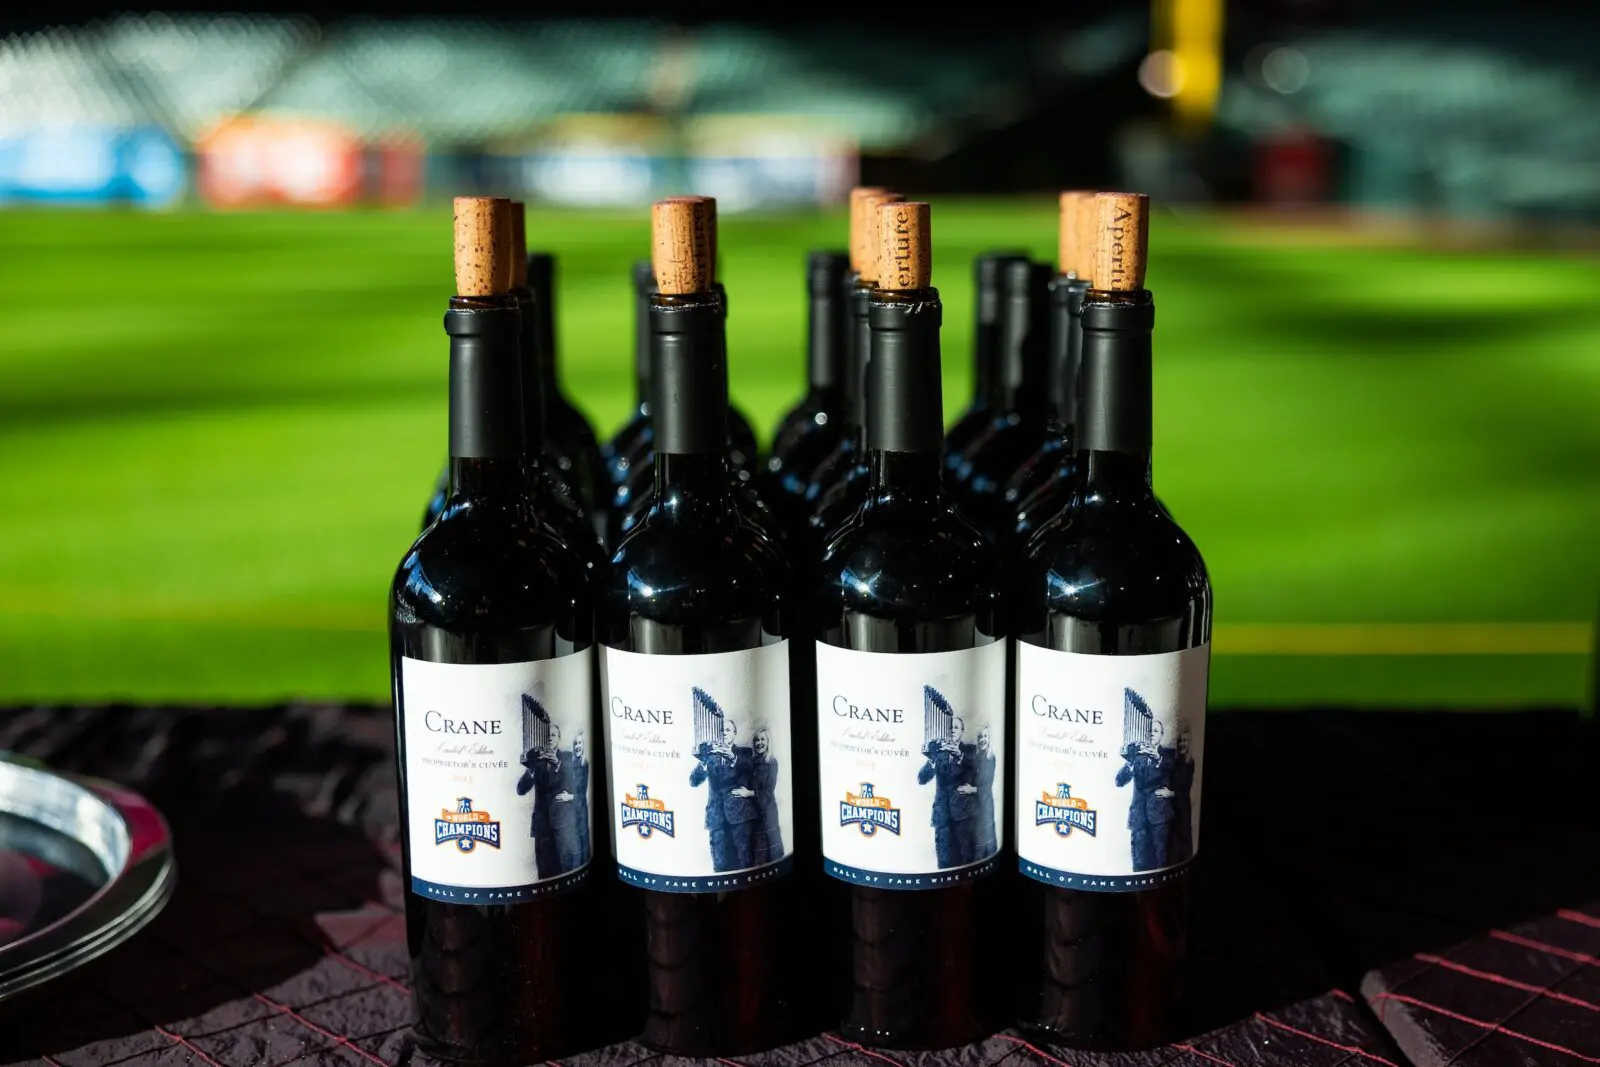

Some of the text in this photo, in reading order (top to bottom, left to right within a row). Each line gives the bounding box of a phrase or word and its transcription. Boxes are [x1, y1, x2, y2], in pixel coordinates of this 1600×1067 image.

[895, 212, 911, 287] erture
[611, 696, 674, 725] CRANE
[832, 695, 904, 723] CRANE
[1031, 694, 1104, 725] CRANE
[425, 710, 502, 735] CRANE
[422, 756, 509, 769] PROPRIETOR'S CUVÉE
[653, 750, 681, 760] CUVÉE
[881, 747, 910, 758] CUVÉE
[1078, 750, 1109, 760] CUVÉE
[855, 798, 881, 807] WORLD
[453, 814, 479, 823] WORLD
[622, 806, 672, 831] CHAMPIONS
[841, 804, 898, 828] CHAMPIONS
[1037, 804, 1094, 830] CHAMPIONS
[436, 822, 498, 842] CHAMPIONS
[665, 880, 697, 888] FAME
[707, 878, 738, 887] WINE
[747, 867, 780, 882] EVENT
[865, 875, 879, 883] OF
[888, 877, 921, 885] FAME
[930, 874, 960, 884] WINE
[1082, 879, 1116, 887] FAME
[1125, 878, 1155, 887] WINE
[489, 891, 522, 899] FAME
[532, 884, 560, 895] WINE
